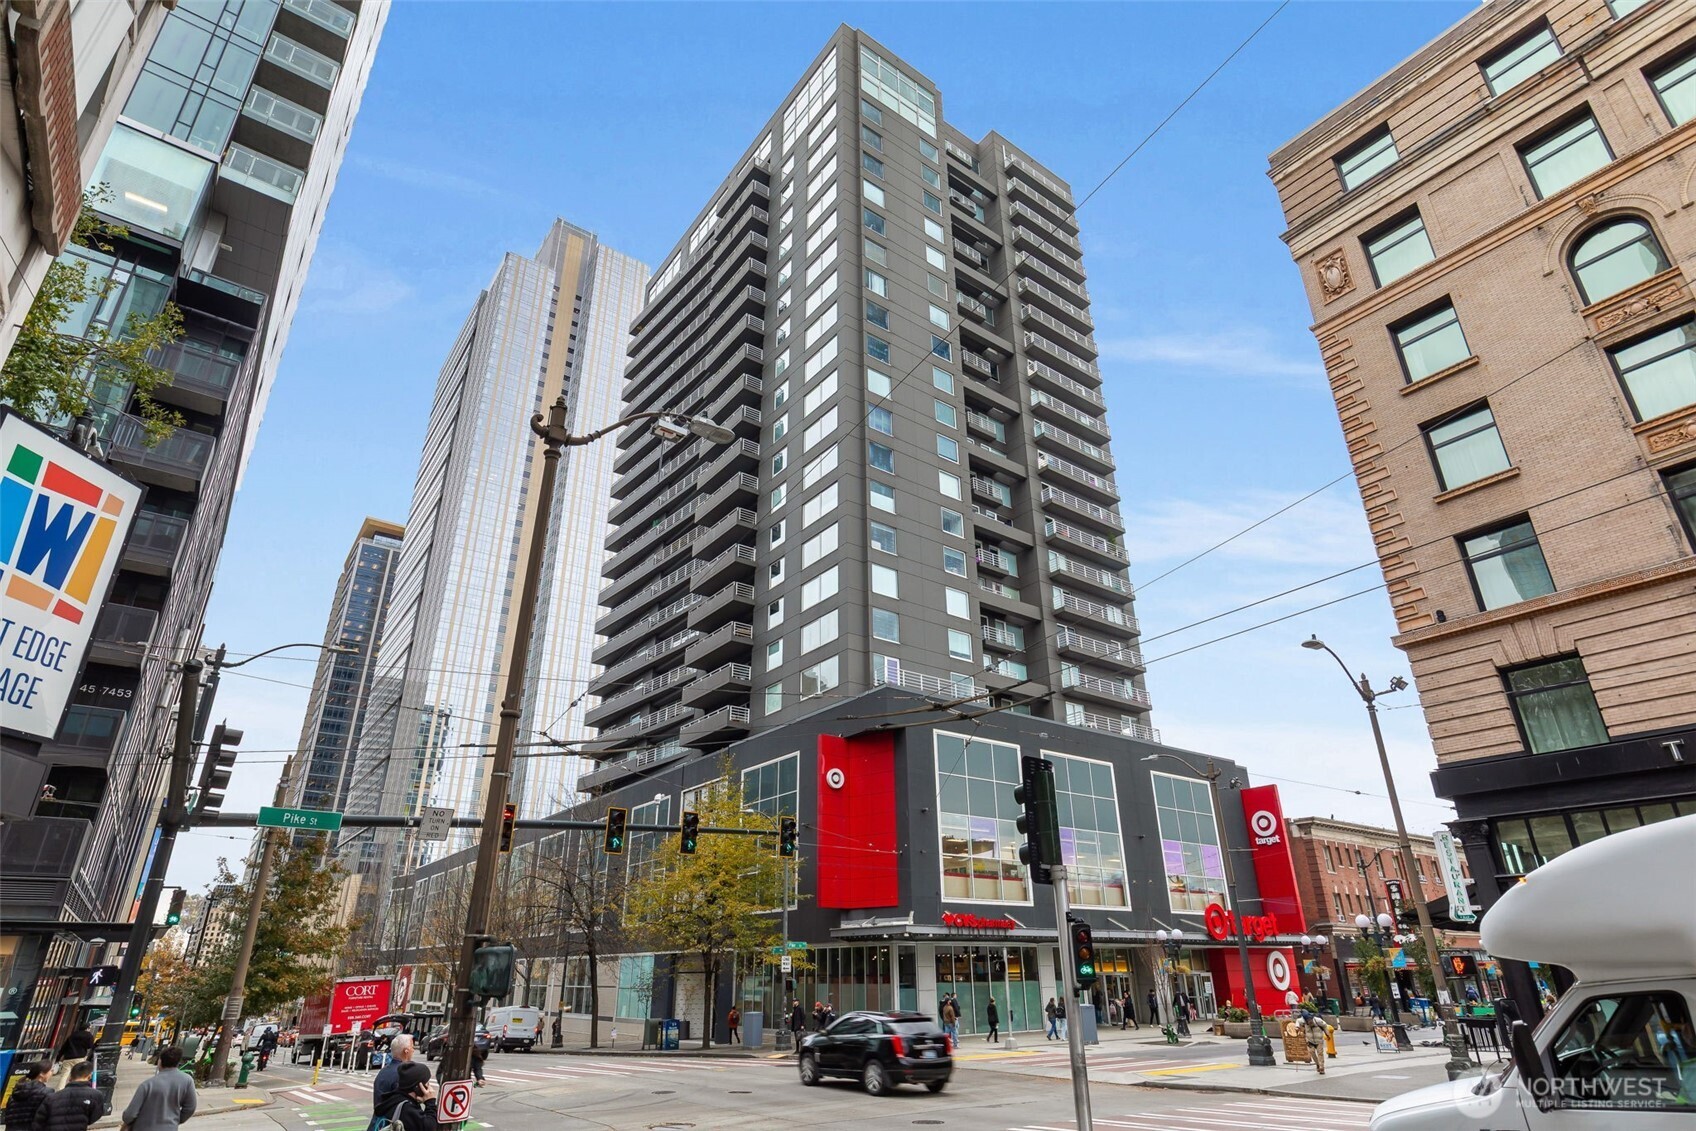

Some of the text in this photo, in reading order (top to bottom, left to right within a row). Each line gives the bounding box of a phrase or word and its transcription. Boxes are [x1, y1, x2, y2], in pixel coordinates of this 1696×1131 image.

[12, 625, 72, 672] EDGE
[282, 812, 318, 826] Pike St
[432, 810, 446, 818] NO
[1255, 835, 1280, 846] target
[1440, 834, 1466, 913] RESTAURANT
[345, 984, 379, 997] CORT
